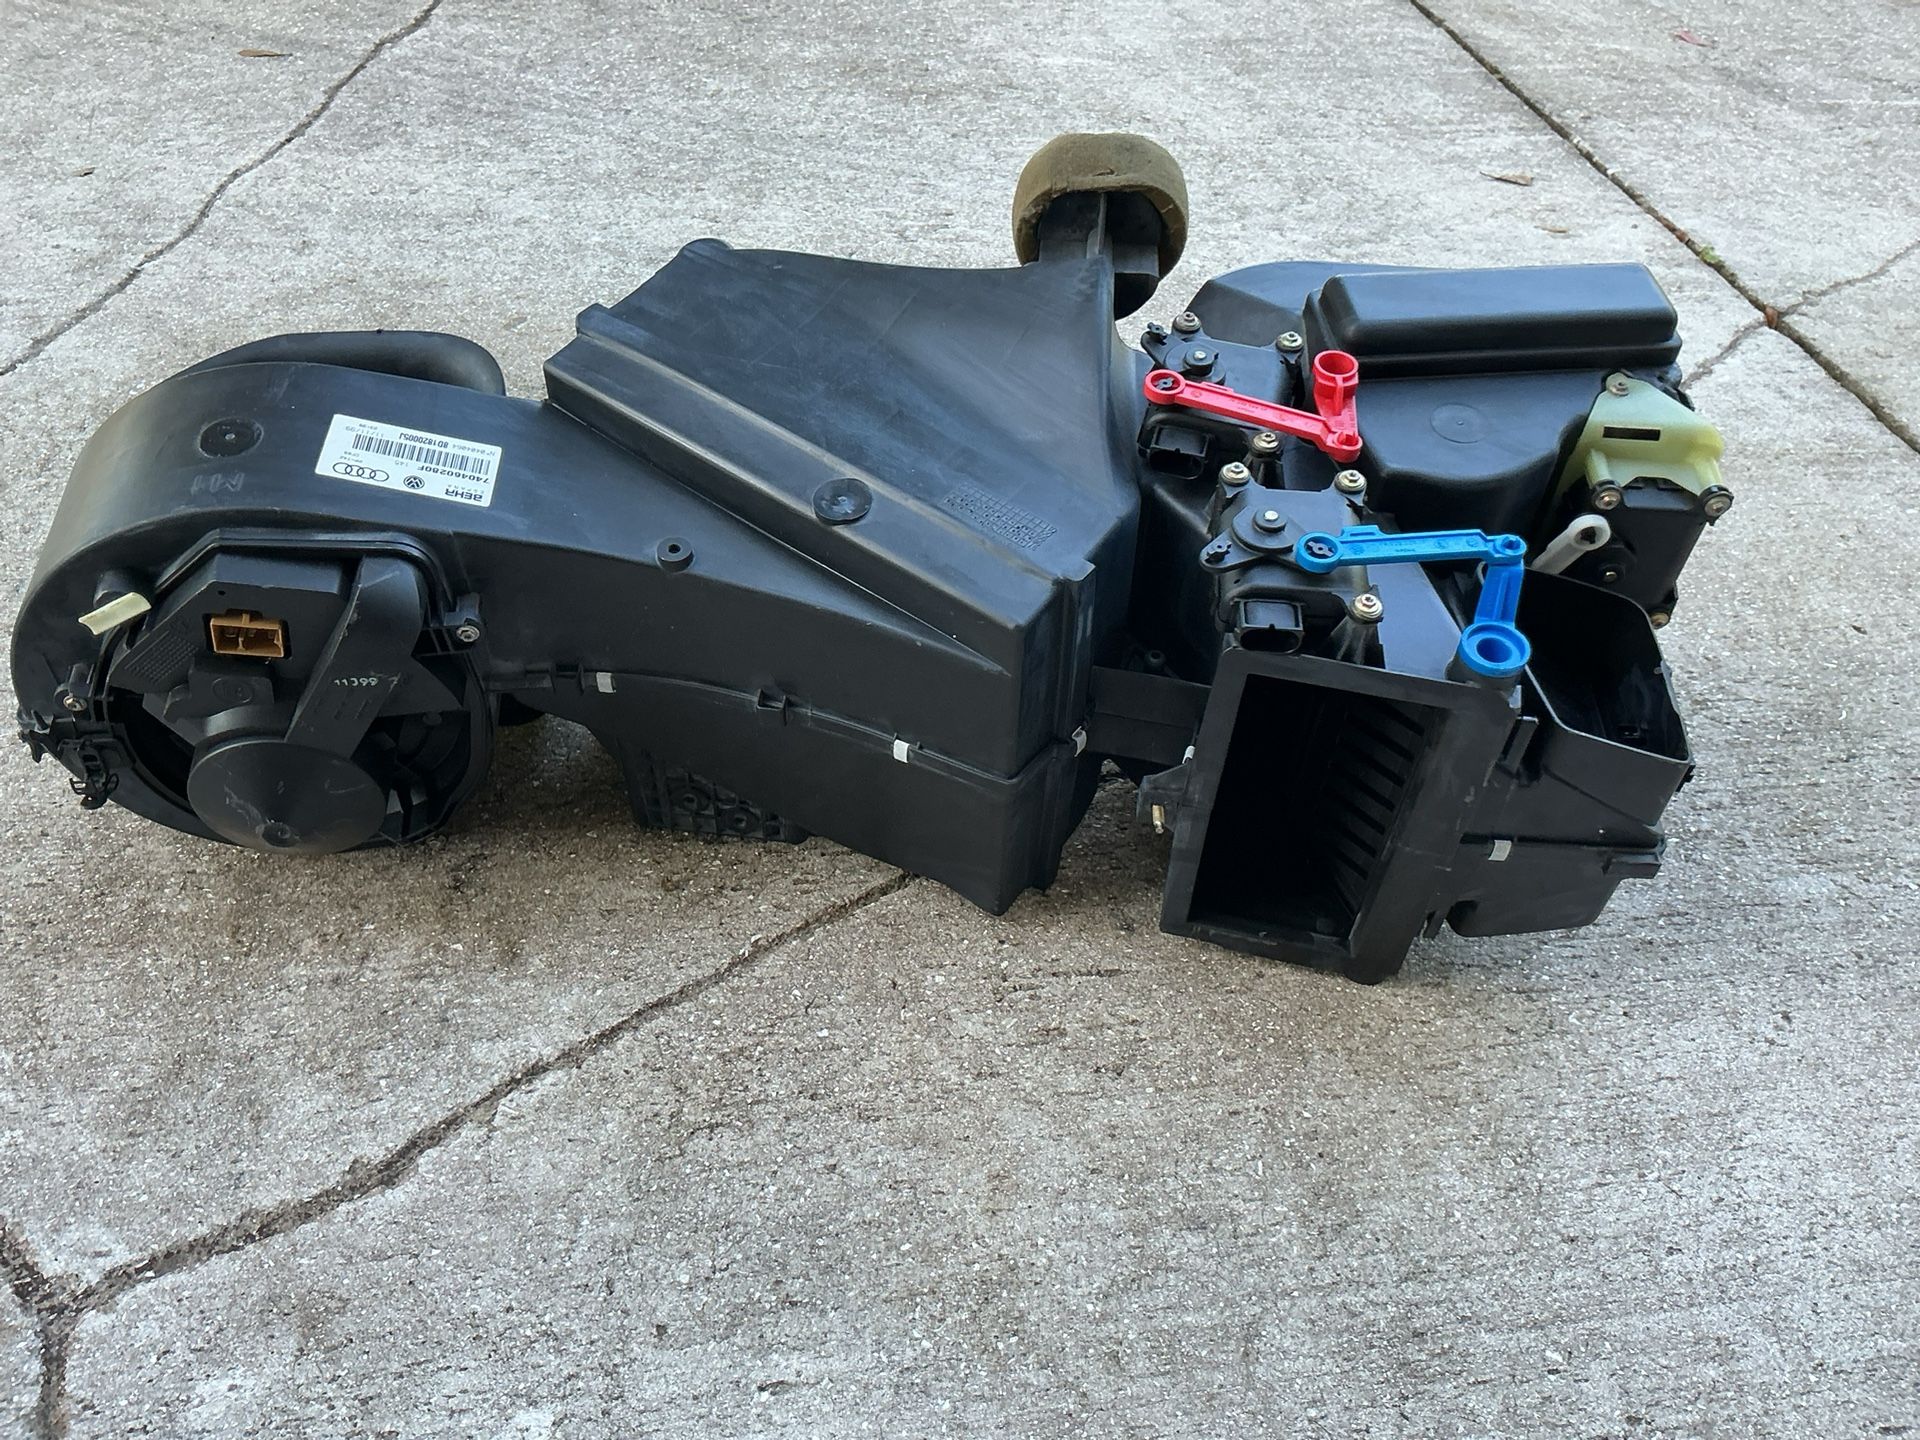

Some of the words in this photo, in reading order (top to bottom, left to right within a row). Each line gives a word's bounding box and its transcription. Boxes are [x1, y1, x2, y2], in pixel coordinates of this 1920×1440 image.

[399, 432, 449, 448] 8D1820005J
[417, 465, 489, 484] 740460280F
[445, 488, 483, 502] BEHR
